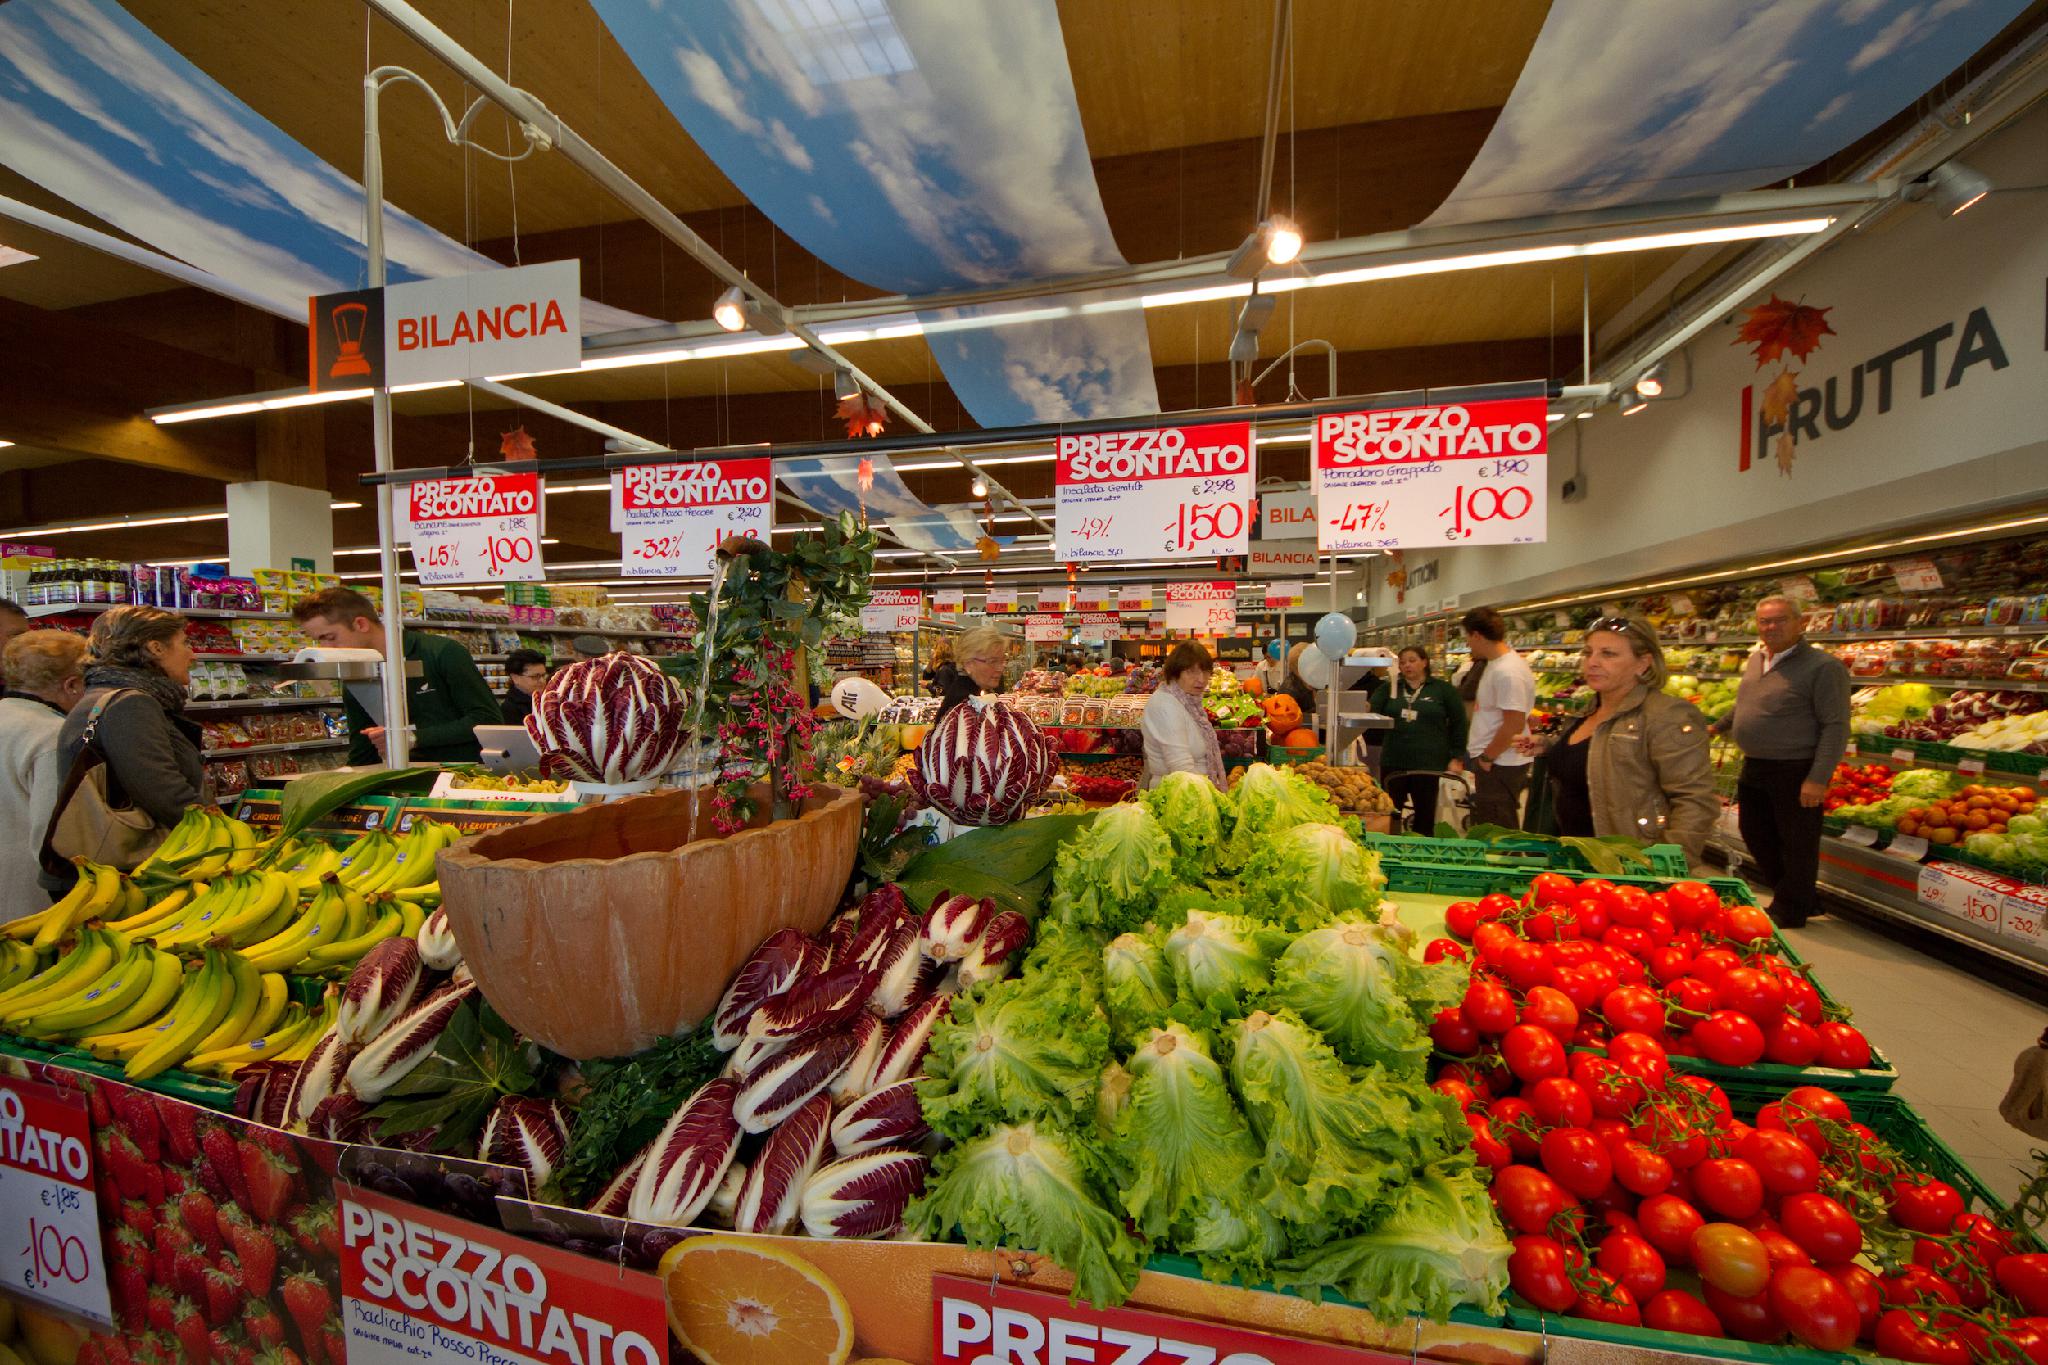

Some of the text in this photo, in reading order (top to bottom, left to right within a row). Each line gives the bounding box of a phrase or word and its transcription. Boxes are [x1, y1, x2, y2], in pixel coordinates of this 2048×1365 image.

[397, 299, 568, 352] BILANCIA
[1321, 406, 1470, 444] PREZZO
[1059, 429, 1185, 461] PREZZO
[1333, 422, 1542, 464] SCONTATO
[625, 462, 721, 489] PREZZO
[1069, 444, 1246, 481] SCONTATO
[1321, 461, 1442, 480] Pomodoro Grappolo
[1478, 466, 1489, 478] €
[413, 477, 496, 502] PREZZO
[418, 490, 534, 519] SCONTATO
[633, 477, 767, 506] SCONTATO
[1329, 500, 1389, 532] -47%
[632, 528, 686, 559] -32%
[1252, 551, 1315, 565] BILANCIA
[866, 590, 901, 598] REZZO
[870, 595, 919, 605] CONTATO
[1167, 582, 1213, 593] PREZZO
[1171, 589, 1235, 600] SCONTATO
[1083, 616, 1119, 624] SCONTATO
[0, 1122, 89, 1181] TATO
[342, 1199, 547, 1306] PREZZO
[361, 1245, 661, 1365] SCONTATO
[351, 1298, 425, 1340] Radicchio
[428, 1324, 475, 1358] Rosso
[942, 1297, 1276, 1365] PREZ
